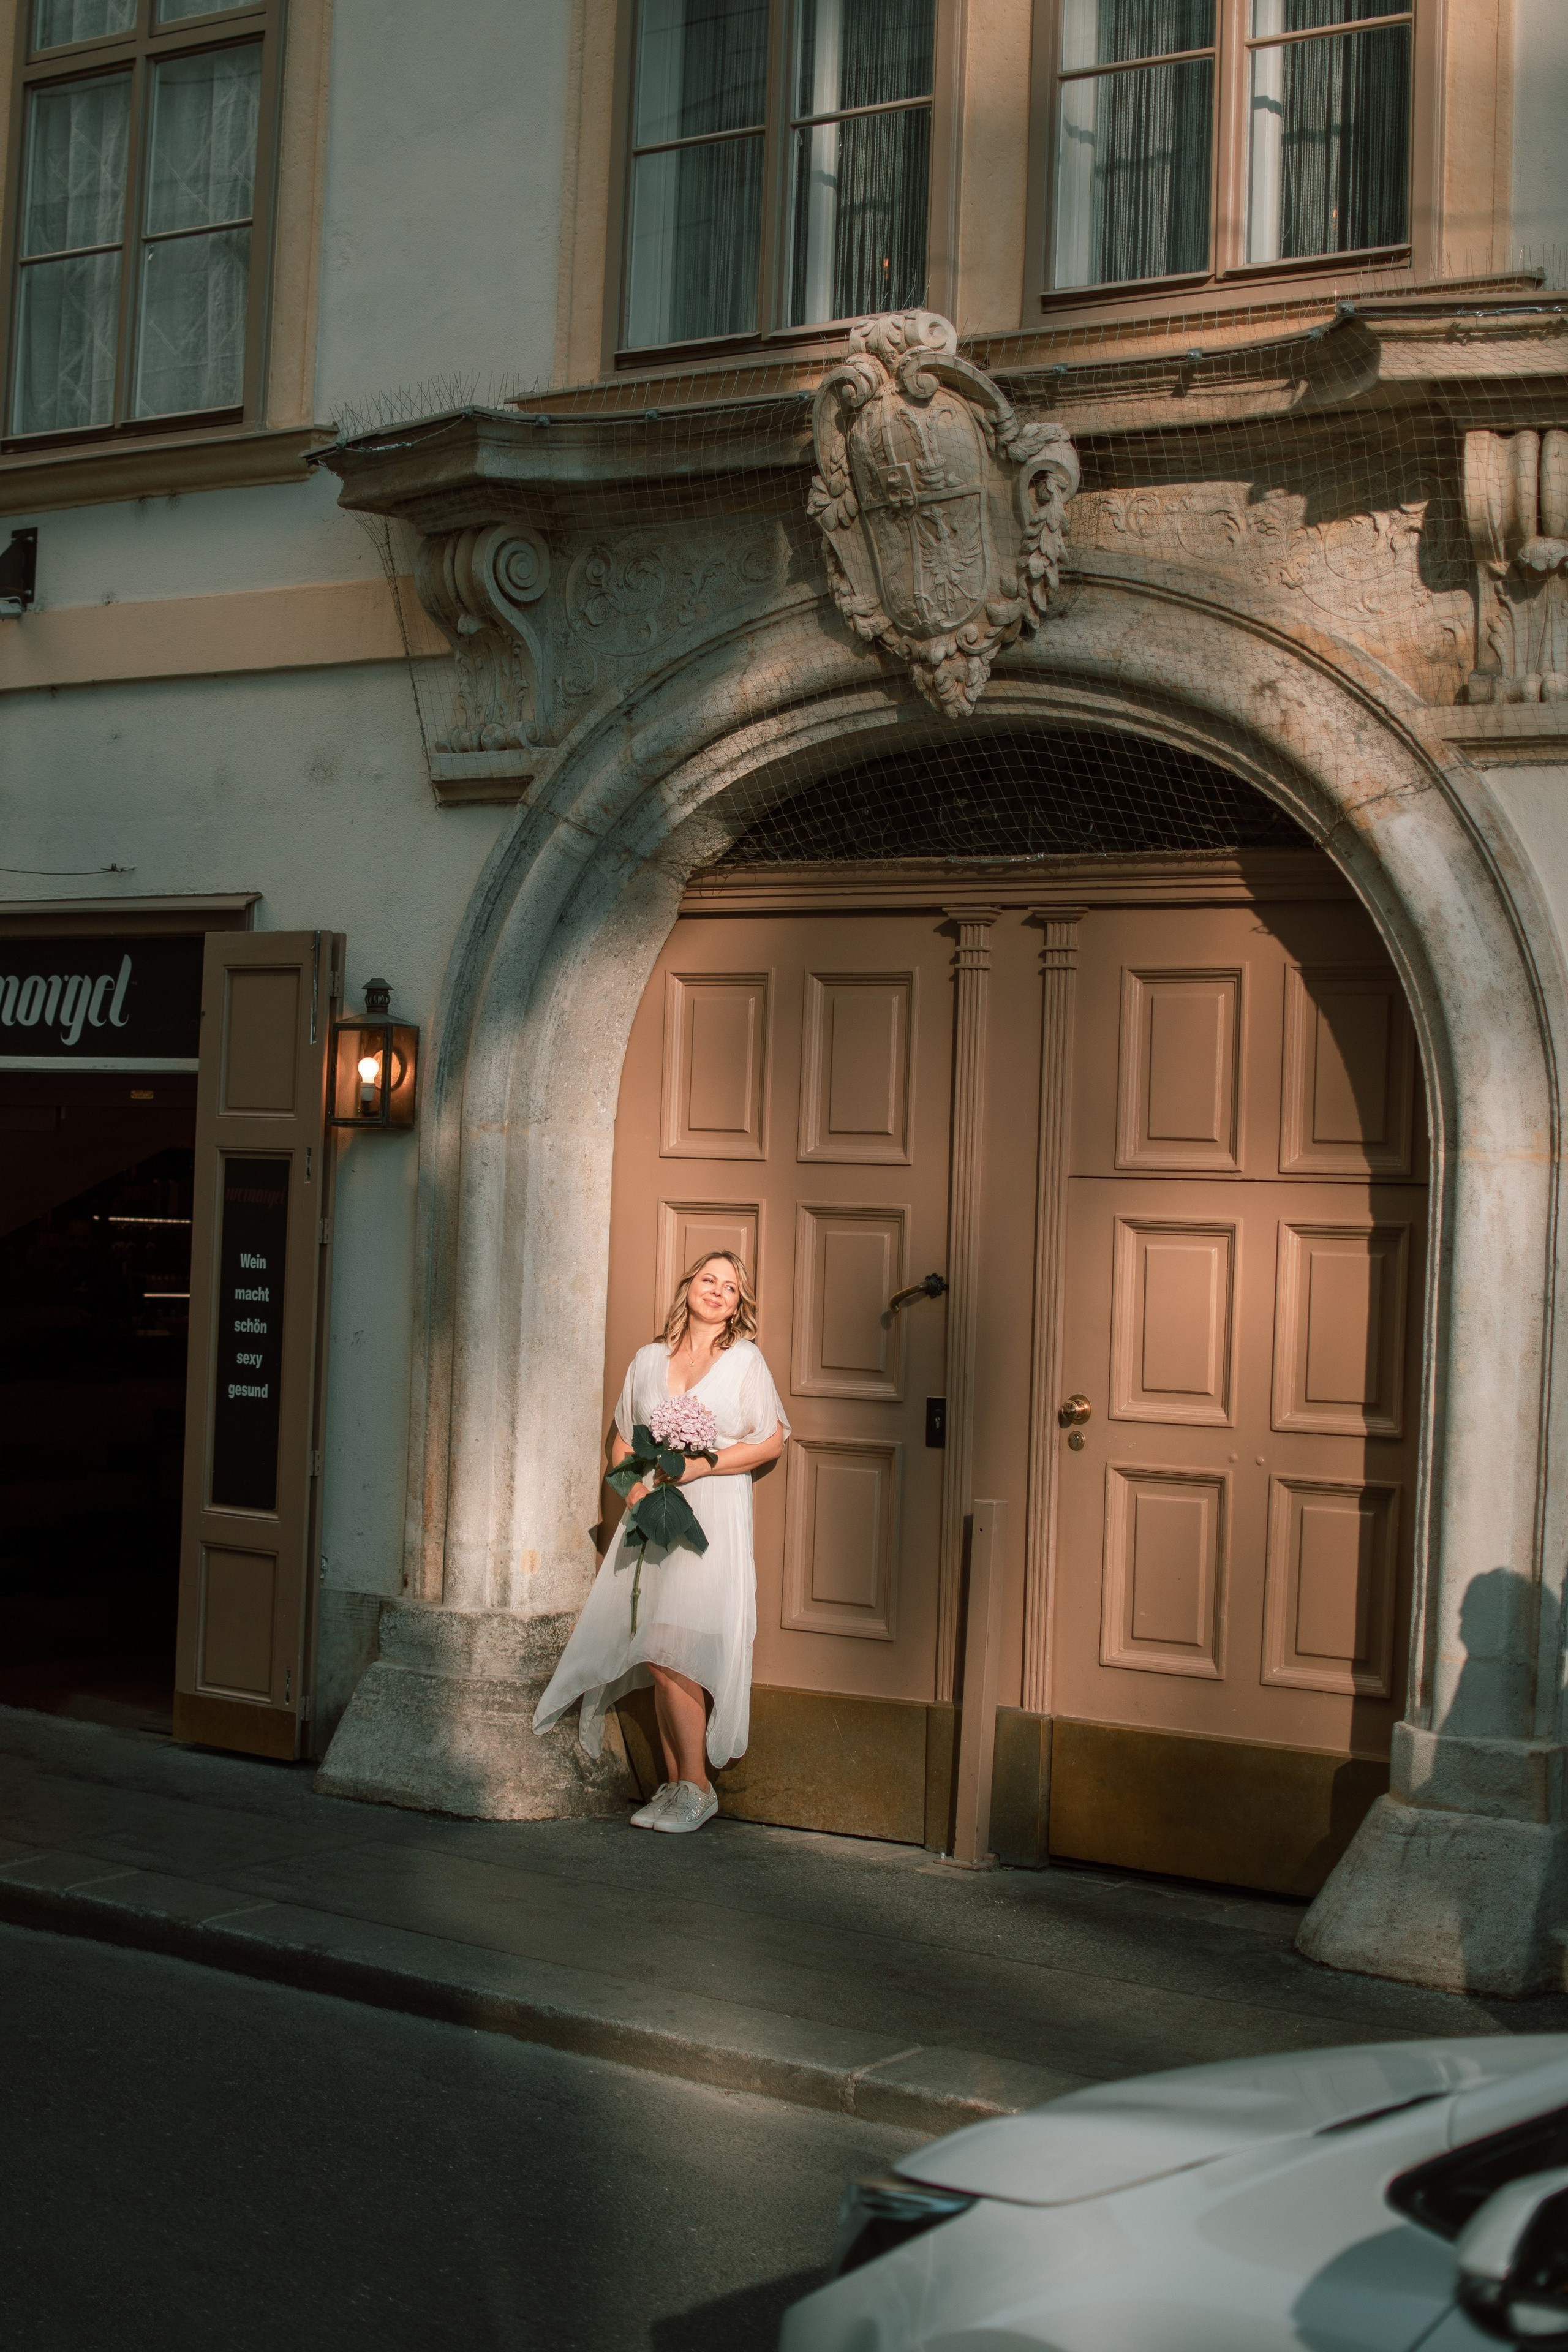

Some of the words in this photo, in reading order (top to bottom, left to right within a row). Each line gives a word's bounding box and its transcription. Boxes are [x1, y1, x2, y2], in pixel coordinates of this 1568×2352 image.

[0, 954, 132, 1046] norgel
[240, 1253, 266, 1269] Wein
[235, 1286, 270, 1302] macht
[234, 1318, 267, 1333] schön
[236, 1352, 263, 1368] sexy
[228, 1384, 268, 1398] gesund
